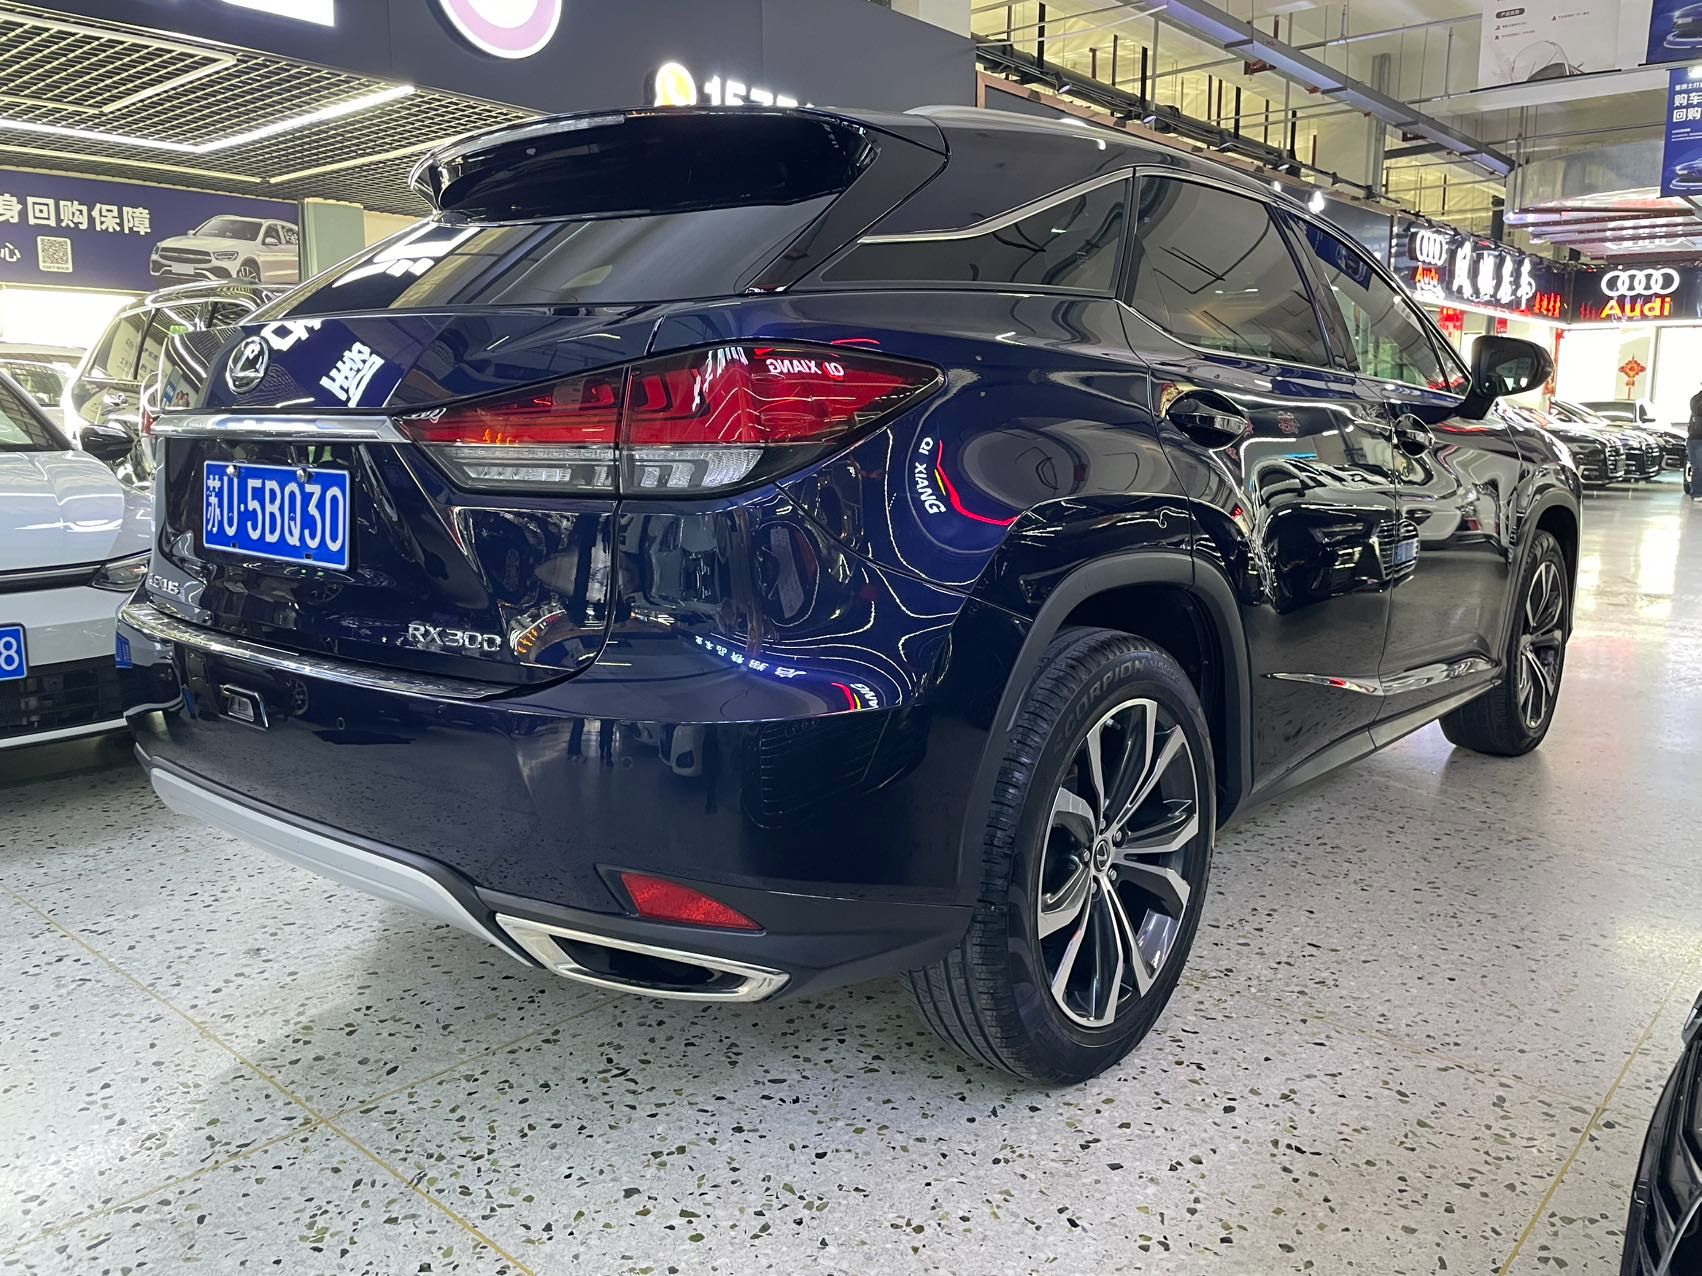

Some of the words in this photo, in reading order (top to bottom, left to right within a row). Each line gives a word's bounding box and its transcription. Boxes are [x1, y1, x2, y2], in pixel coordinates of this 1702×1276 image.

[1600, 297, 1672, 318] Audi
[915, 462, 946, 514] XIANG
[408, 623, 501, 651] RX300
